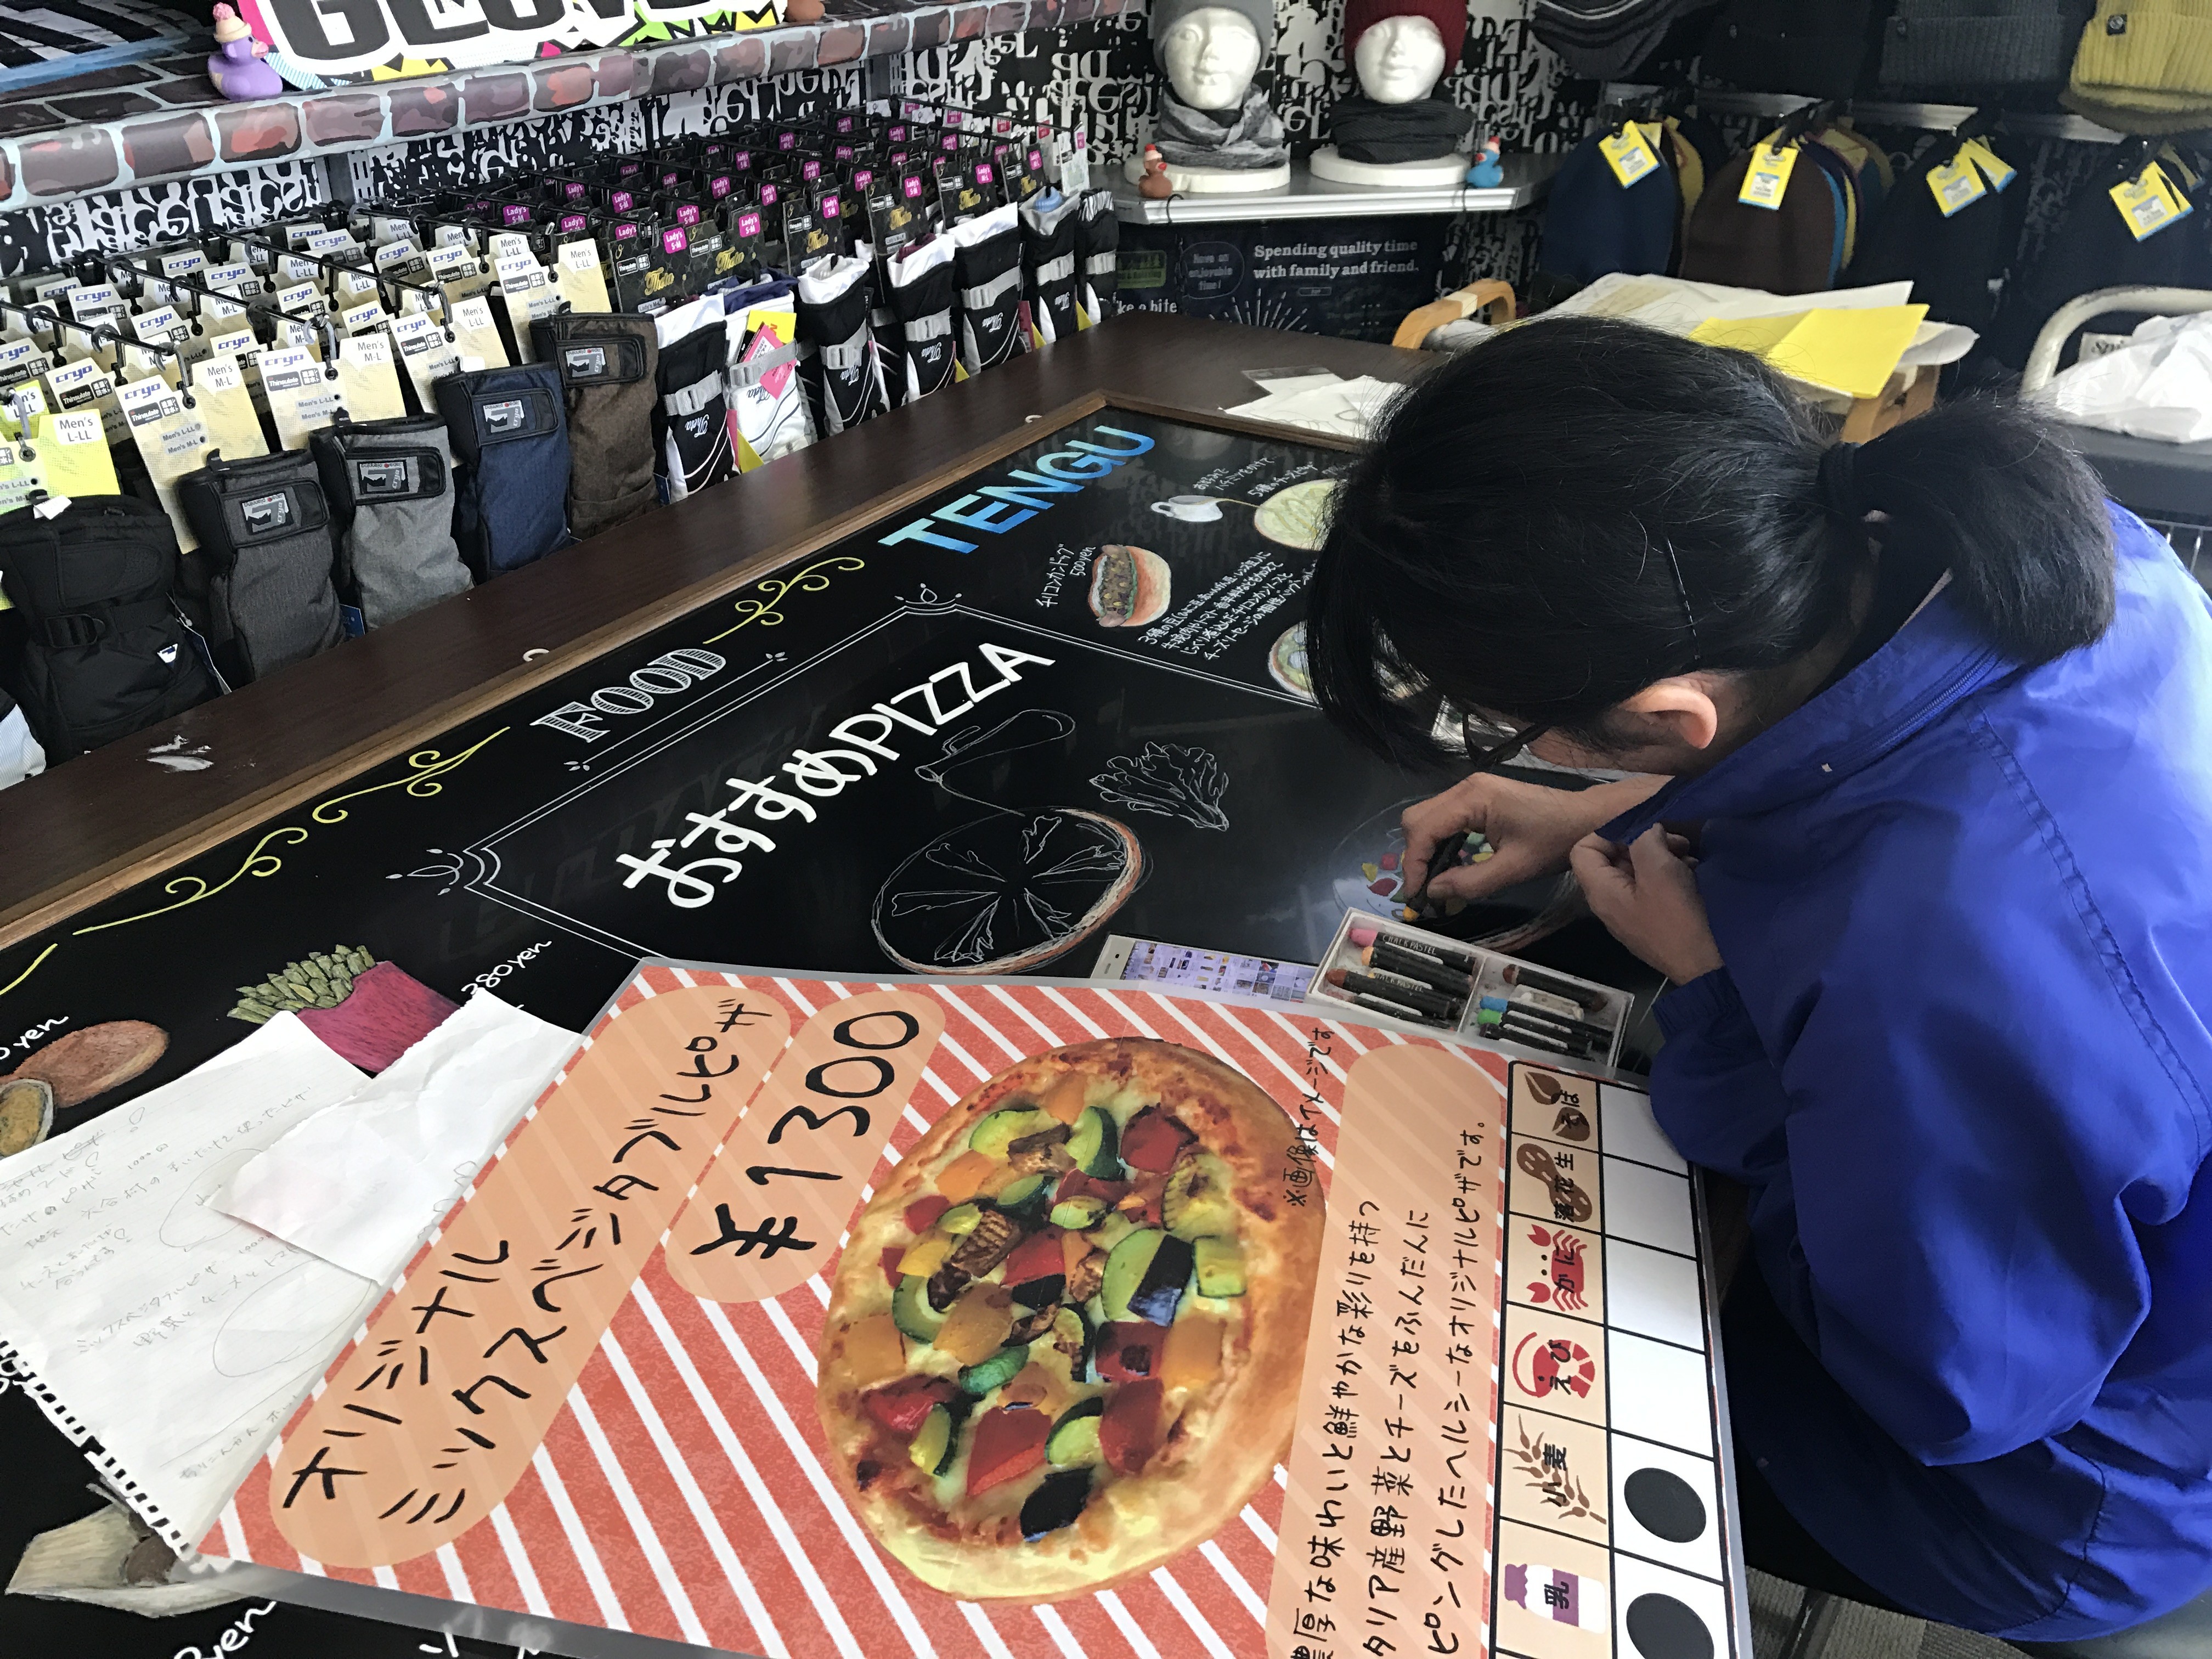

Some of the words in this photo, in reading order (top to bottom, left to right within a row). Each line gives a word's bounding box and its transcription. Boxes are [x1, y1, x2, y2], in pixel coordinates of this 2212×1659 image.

[805, 163, 819, 173] Lady's
[978, 167, 990, 175] Lady's
[857, 173, 871, 182] Lady's
[713, 179, 727, 189] Lady's
[906, 179, 919, 188] Lady's
[763, 187, 775, 196] Lady's
[614, 193, 629, 203] Lady's
[825, 197, 837, 208] Lady's
[507, 206, 527, 215] Lady's
[619, 201, 629, 210] S-M
[680, 207, 696, 218] Lady's
[565, 217, 583, 228] Lady's
[741, 216, 758, 226] Lady's
[619, 225, 637, 236] Lady's
[746, 225, 755, 234] S-M
[314, 235, 347, 247] cryo
[666, 230, 683, 242] Lady's
[500, 238, 521, 247] Men's
[671, 240, 682, 250] S-M
[379, 246, 409, 261] cryo
[433, 250, 462, 262] cryo
[506, 247, 521, 257] L-LL
[571, 250, 591, 259] Men's
[1254, 244, 1327, 261] Spending
[1330, 241, 1382, 258] quality
[1384, 240, 1418, 252] time
[168, 257, 201, 269] cryo
[501, 259, 531, 271] cryo
[575, 259, 590, 268] L-LL
[211, 268, 246, 280] cryo
[295, 268, 314, 278] L-LL
[1254, 265, 1286, 279] with
[1289, 264, 1340, 279] family
[1341, 261, 1368, 275] and
[1370, 259, 1419, 273] friend.
[356, 280, 370, 291] L-LL
[75, 290, 111, 303] cryo
[284, 288, 313, 302] cryo
[222, 304, 238, 315] M-L
[528, 300, 544, 308] Men's
[350, 308, 377, 322] cryo
[463, 307, 483, 317] Men's
[140, 312, 172, 329] cryo
[397, 319, 426, 332] cryo
[469, 318, 484, 327] L-LL
[218, 336, 250, 349] cryo
[358, 341, 384, 351] Men's
[265, 353, 304, 366] cryo
[365, 352, 381, 360] M-L
[55, 365, 93, 383] cryo
[208, 365, 233, 376] Men's
[216, 379, 233, 387] M-L
[269, 377, 298, 387] Thinsulate
[125, 383, 160, 399] cryo
[63, 391, 91, 404] Thinsulate
[319, 397, 334, 405] L-LL
[131, 410, 160, 421] Thinsulate
[302, 411, 321, 420] Men's
[59, 417, 93, 429] Men's
[685, 414, 710, 438] Theta
[68, 430, 92, 442] L-LL
[162, 430, 180, 441] Men's
[168, 444, 185, 454] Men's
[878, 425, 1155, 555] TENGU
[531, 648, 726, 743] FOOD
[1383, 934, 1408, 947] CHALK
[1410, 940, 1437, 955] PASTEL
[1559, 1090, 1581, 1128] そば
[1554, 1152, 1575, 1222] 落花生
[1554, 1246, 1575, 1294] かに
[1548, 1340, 1572, 1395] えび
[282, 1240, 509, 1509] オリジナル
[1542, 1443, 1567, 1507] 小麦
[1544, 1581, 1570, 1610] 乳
